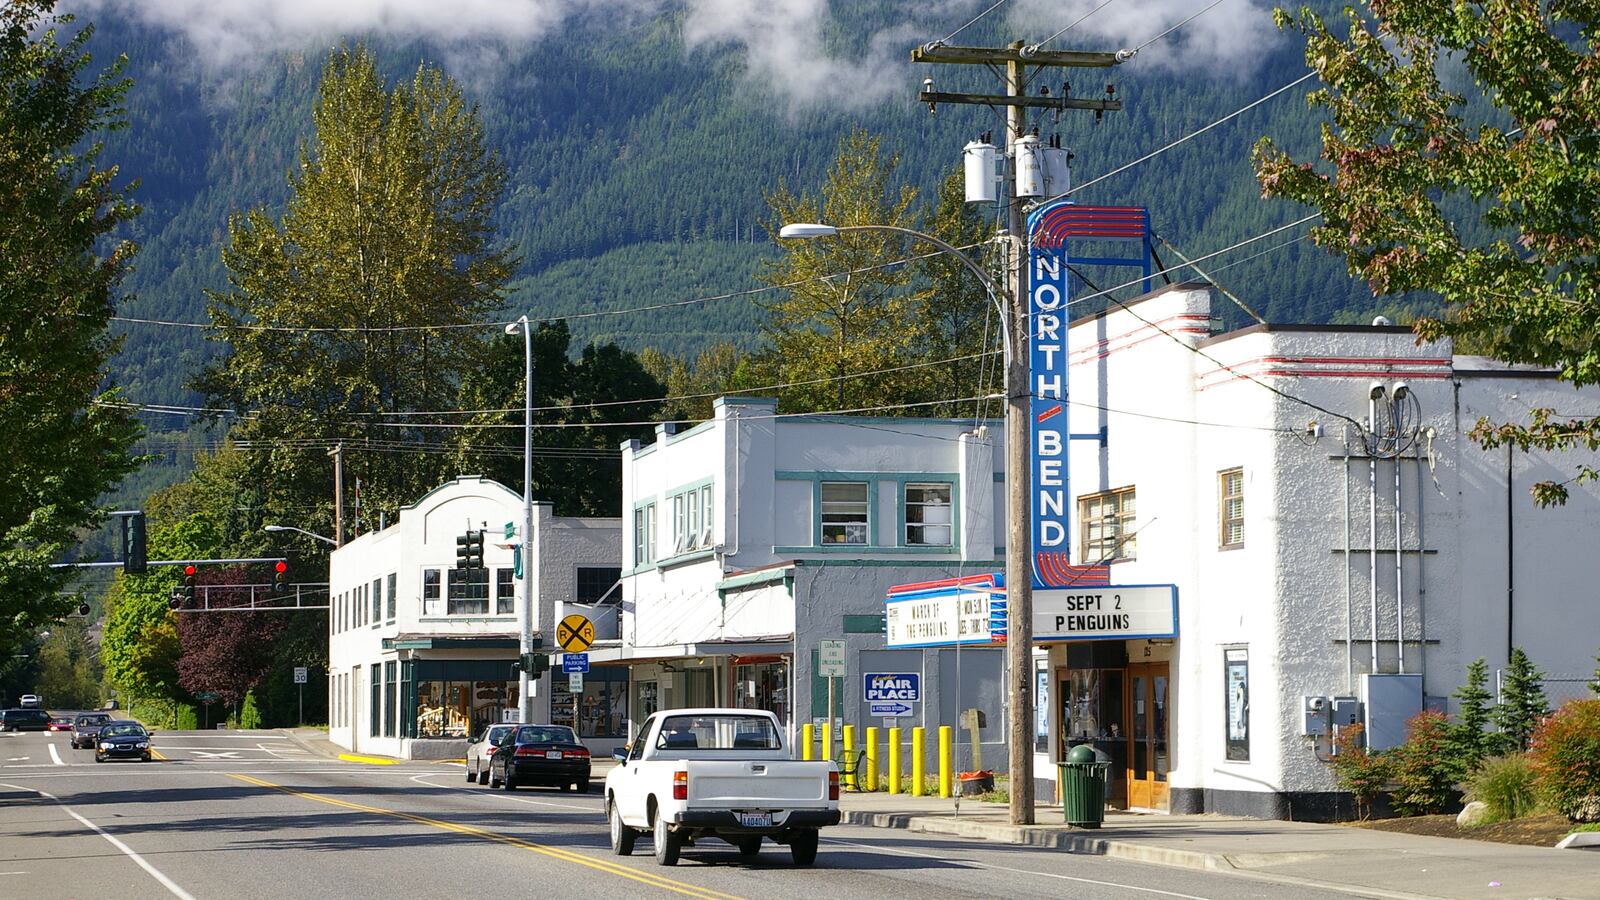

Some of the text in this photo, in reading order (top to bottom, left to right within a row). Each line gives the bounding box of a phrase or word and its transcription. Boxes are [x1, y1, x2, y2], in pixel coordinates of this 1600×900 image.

[1034, 255, 1061, 400] NORTH
[1037, 429, 1065, 547] BEND
[912, 603, 931, 619] MARCH
[933, 602, 939, 618] OF
[1066, 594, 1121, 611] SEPT 2
[906, 623, 916, 639] THE
[919, 620, 948, 638] PENGUINS
[1055, 614, 1130, 631] PENGUINS
[560, 628, 592, 639] R R
[295, 674, 306, 682] 30
[871, 679, 912, 689] HAIR
[868, 689, 916, 700] PLACE
